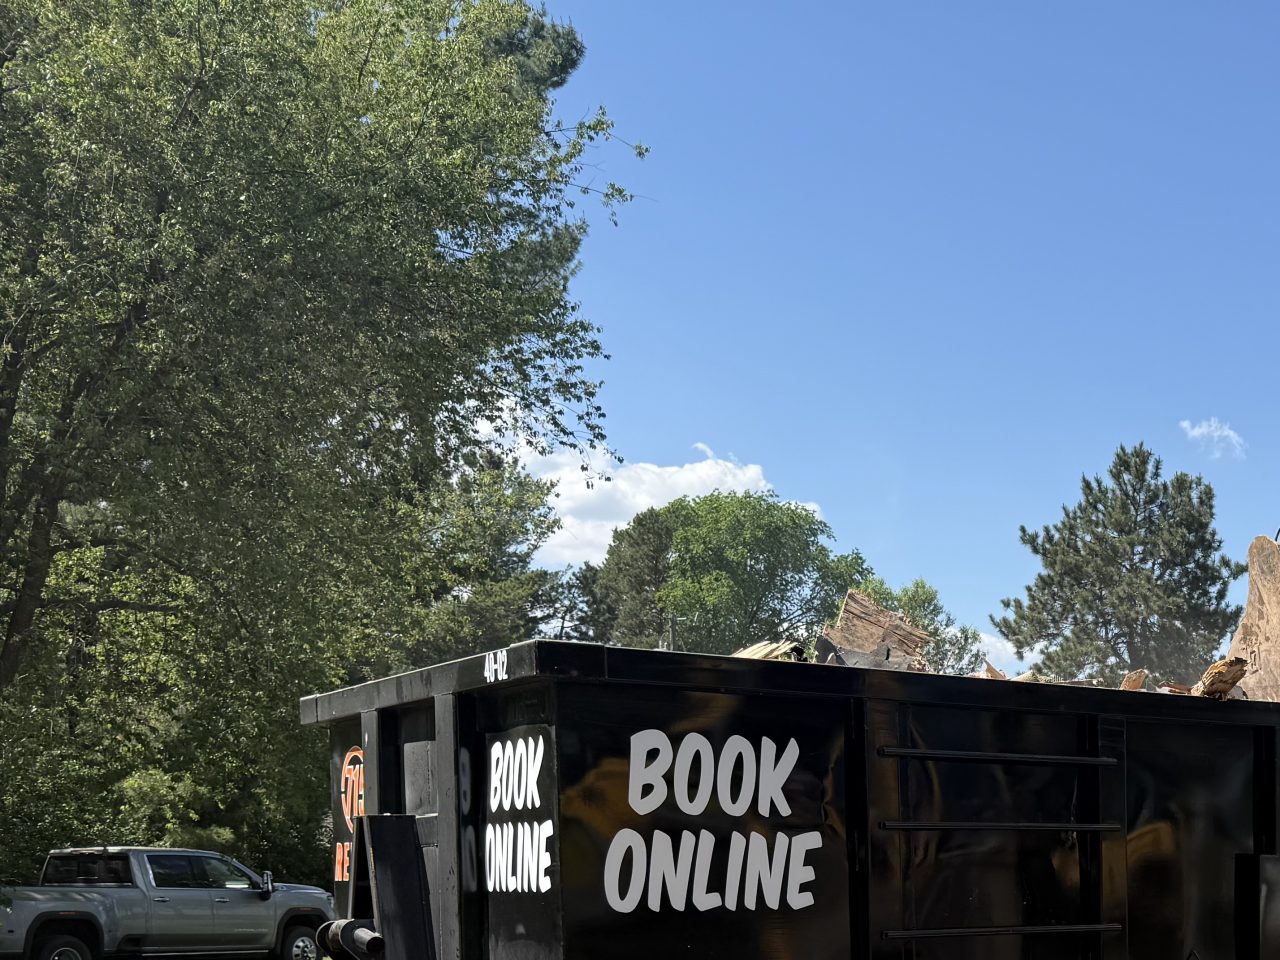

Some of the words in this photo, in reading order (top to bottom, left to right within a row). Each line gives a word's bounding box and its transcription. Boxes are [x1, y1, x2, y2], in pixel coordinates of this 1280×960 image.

[484, 649, 508, 683] 40-02
[490, 735, 544, 813] BOOK
[628, 729, 800, 818] BOOK
[485, 819, 554, 893] ONLINE
[604, 828, 824, 914] ONLINE
